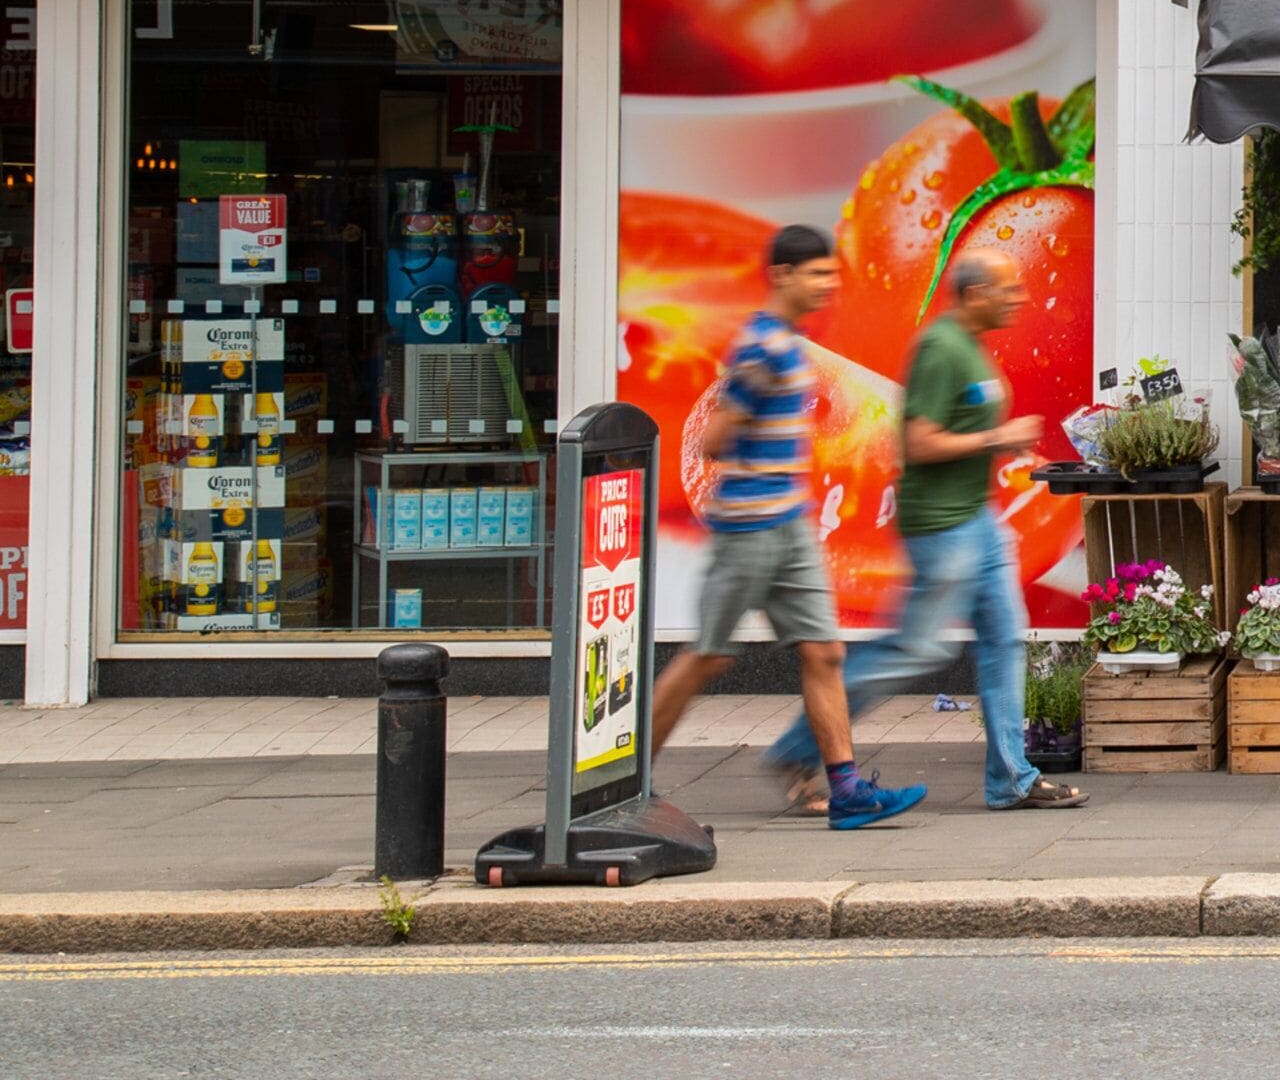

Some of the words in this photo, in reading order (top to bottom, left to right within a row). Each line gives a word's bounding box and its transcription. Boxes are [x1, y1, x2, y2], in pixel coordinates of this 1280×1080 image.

[464, 76, 523, 93] SPECIAL
[464, 94, 523, 126] OFFERS
[236, 201, 272, 209] GREAT
[237, 209, 272, 224] VALUE
[221, 341, 248, 351] Extra
[222, 488, 249, 499] Extra
[601, 478, 628, 504] PRICE
[600, 503, 628, 552] CUTS
[592, 593, 606, 622] £5
[618, 587, 632, 617] £4
